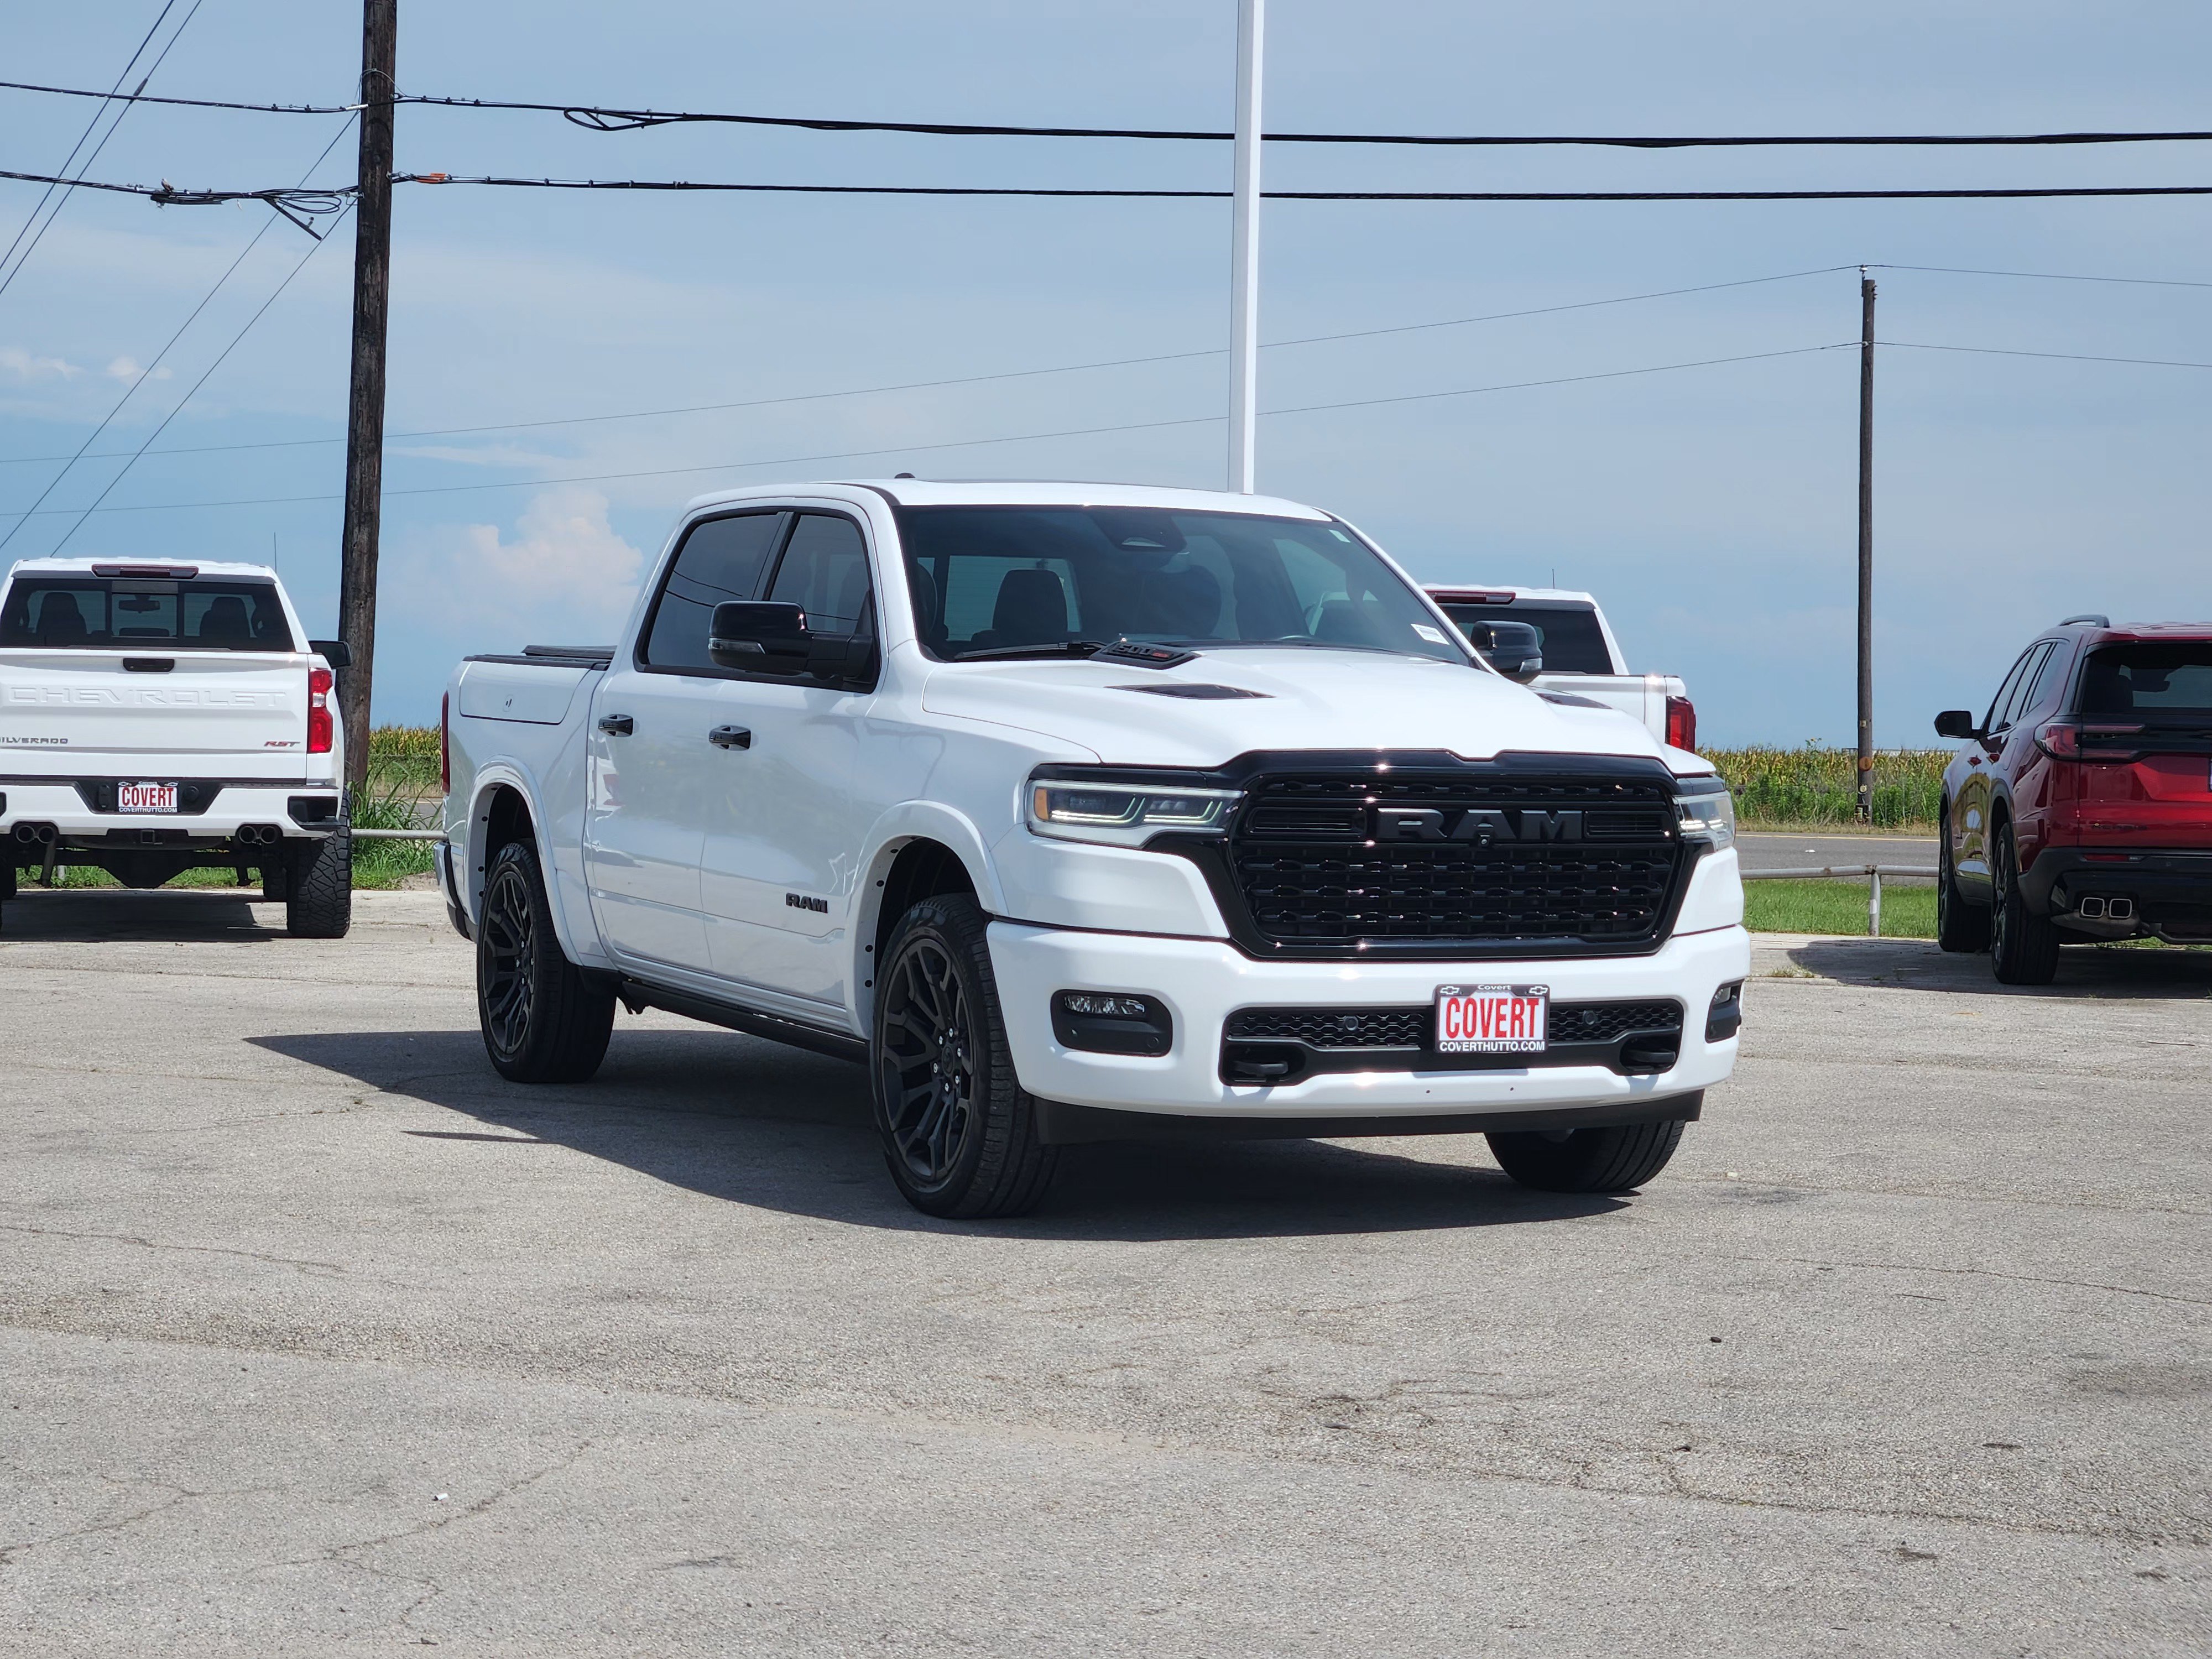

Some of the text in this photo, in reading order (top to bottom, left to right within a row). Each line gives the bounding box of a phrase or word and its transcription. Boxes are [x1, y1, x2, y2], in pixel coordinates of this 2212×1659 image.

[9, 687, 286, 706] CHEVROLET
[122, 787, 174, 806] COVERT
[1376, 807, 1583, 839] RAM
[786, 893, 828, 914] RAM
[1446, 997, 1540, 1039] COVERT
[1439, 1041, 1545, 1052] COVERTHUTTO.COM
